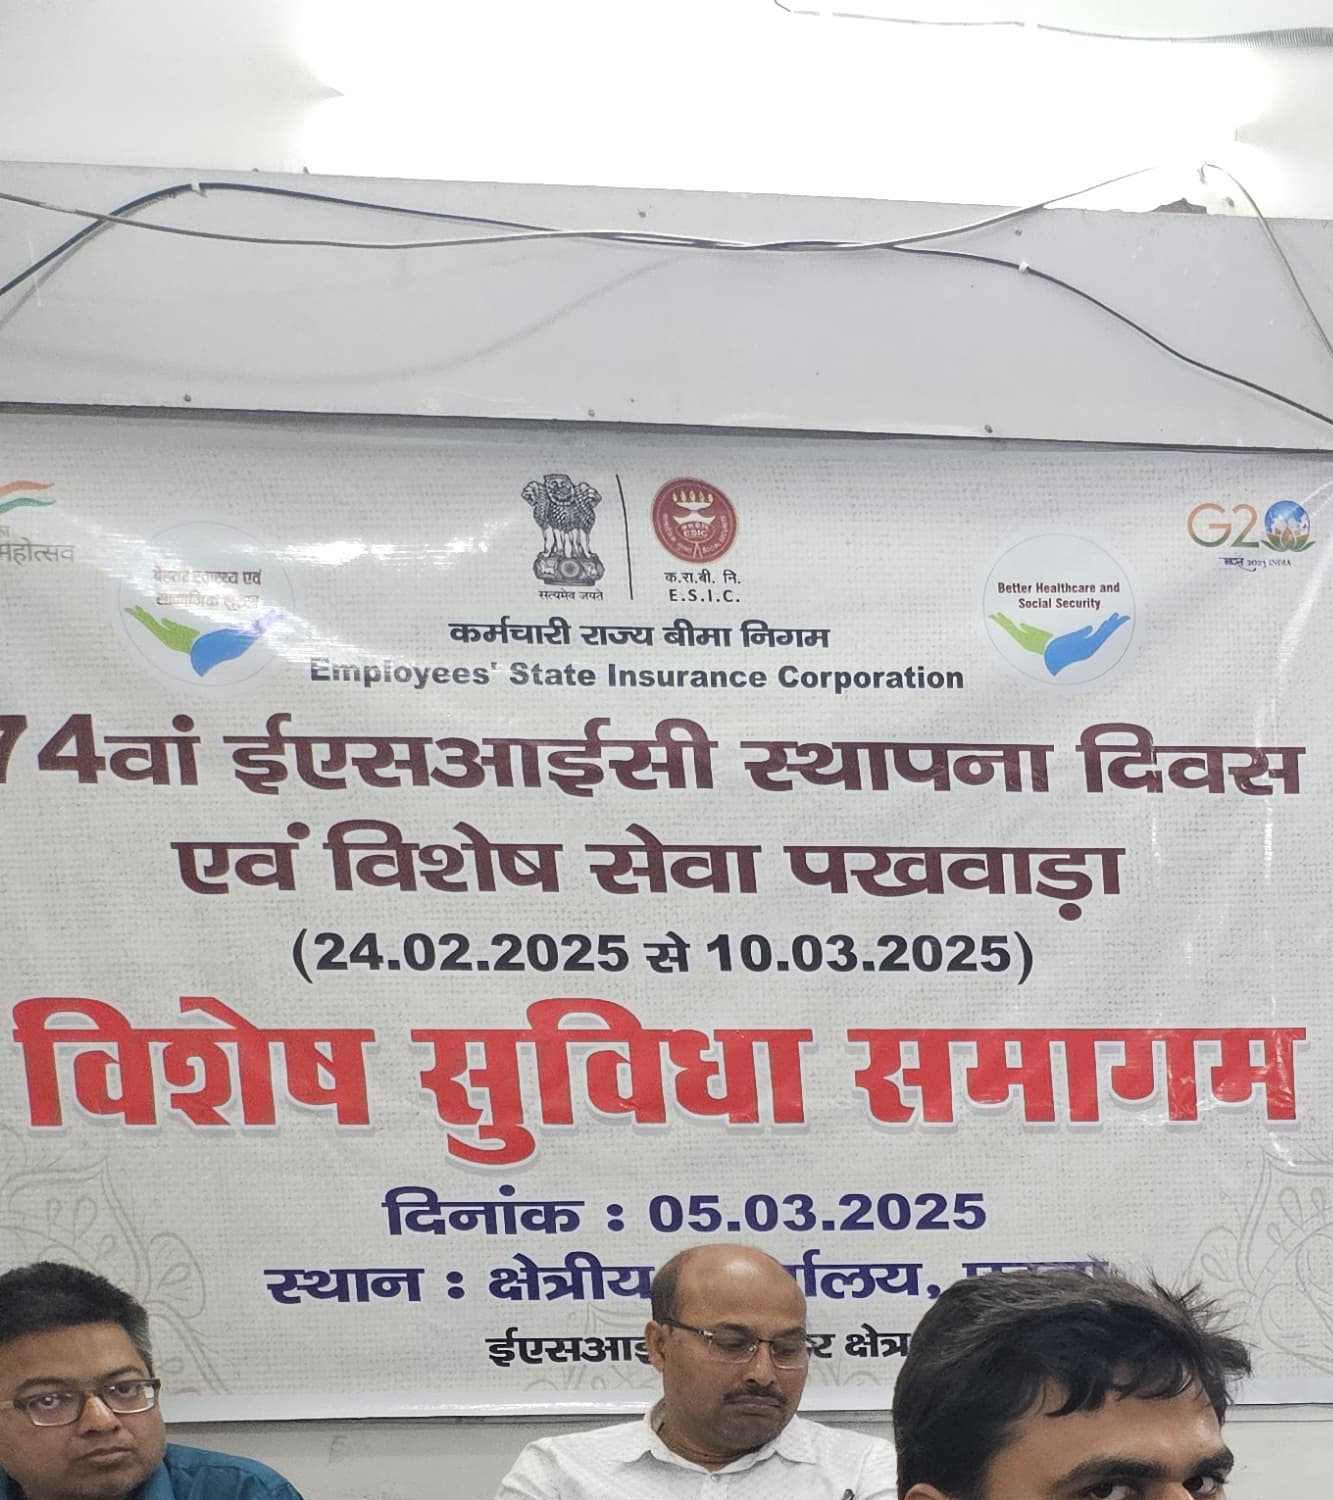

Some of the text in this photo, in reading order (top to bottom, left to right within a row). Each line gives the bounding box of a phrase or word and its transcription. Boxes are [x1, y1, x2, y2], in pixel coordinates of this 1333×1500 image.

[669, 589, 740, 603] E.S.I.C.
[998, 582, 1120, 594] Better Healthcare and
[1018, 597, 1101, 611] Social Security
[449, 616, 830, 649] कर्मचारी राज्य बीमा निगम
[510, 662, 596, 687] State
[608, 663, 768, 688] Insurance
[778, 666, 964, 695] Corporation
[223, 713, 717, 797] ईएसआईसी
[740, 741, 1054, 794] स्थापना
[1075, 722, 1306, 796] दिवस
[171, 819, 1126, 921] एवं विशेष सेवा पखवाड़ा
[292, 929, 1035, 985] (24.02.2025 से 10.03.2025)
[12, 996, 1307, 1167] विशेष सुविधा समागम
[382, 1185, 585, 1236] दिनांक
[649, 1192, 987, 1233] 05.03.2025
[264, 1266, 424, 1304] स्थान
[489, 1251, 655, 1302] क्षेत्रीय
